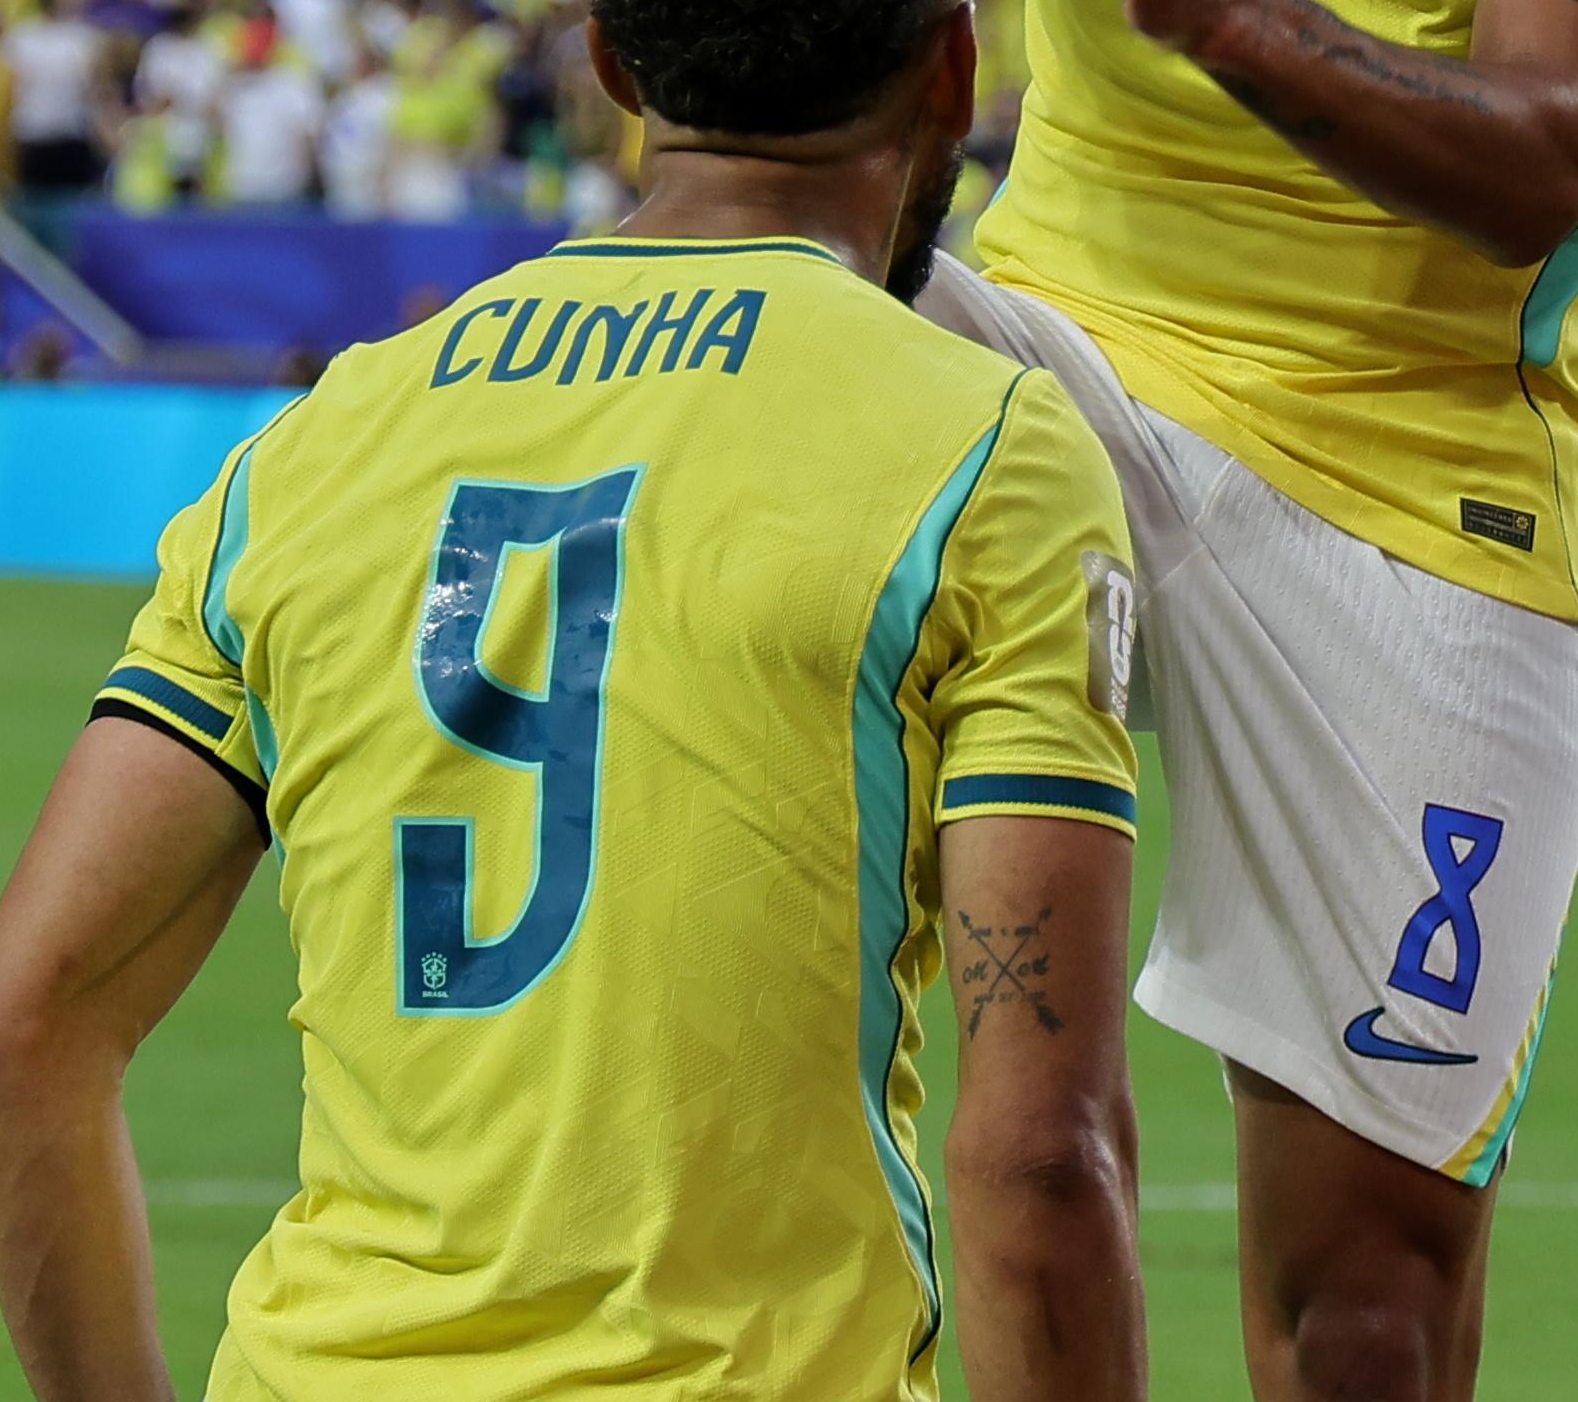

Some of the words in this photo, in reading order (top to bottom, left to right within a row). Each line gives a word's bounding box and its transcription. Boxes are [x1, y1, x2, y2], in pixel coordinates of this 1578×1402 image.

[428, 287, 769, 390] CUNHA
[390, 463, 647, 1018] 9
[1386, 802, 1505, 1015] 8
